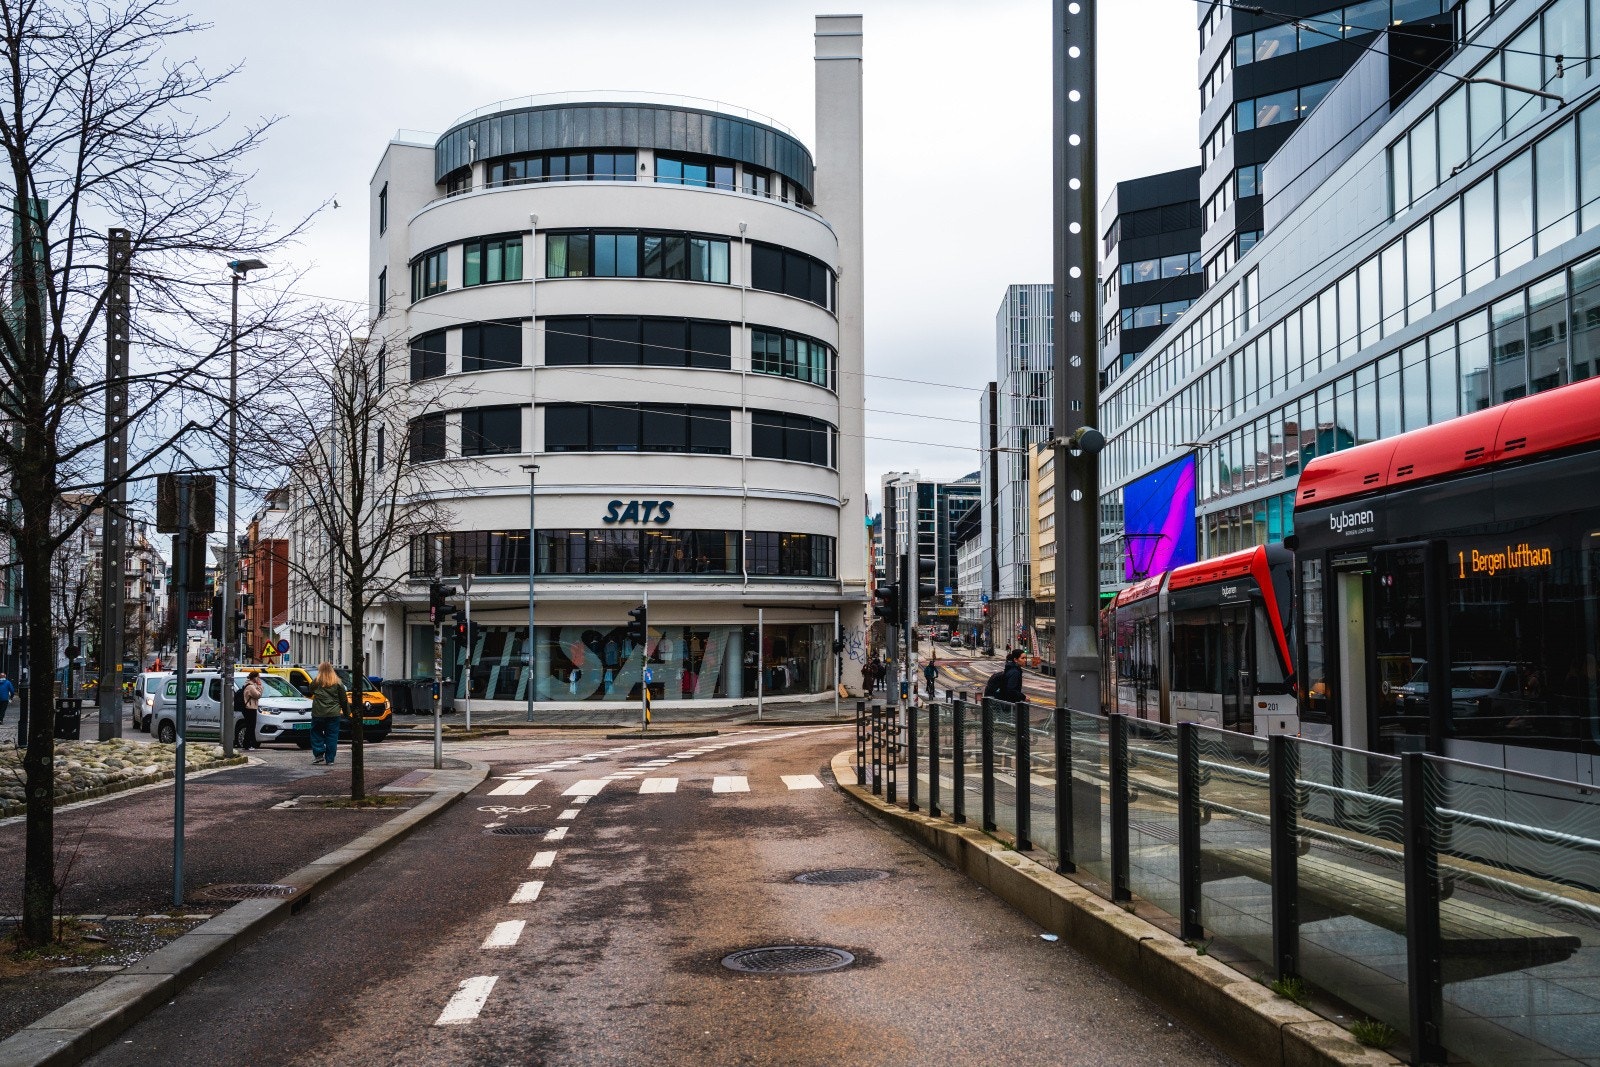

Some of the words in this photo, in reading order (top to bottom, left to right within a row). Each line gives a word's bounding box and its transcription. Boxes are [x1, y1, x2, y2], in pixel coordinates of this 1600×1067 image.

[602, 500, 674, 525] SATS
[1330, 510, 1374, 533] bybanen
[1458, 551, 1465, 578] 1
[1471, 549, 1506, 576] Bergen
[1268, 703, 1279, 711] 201
